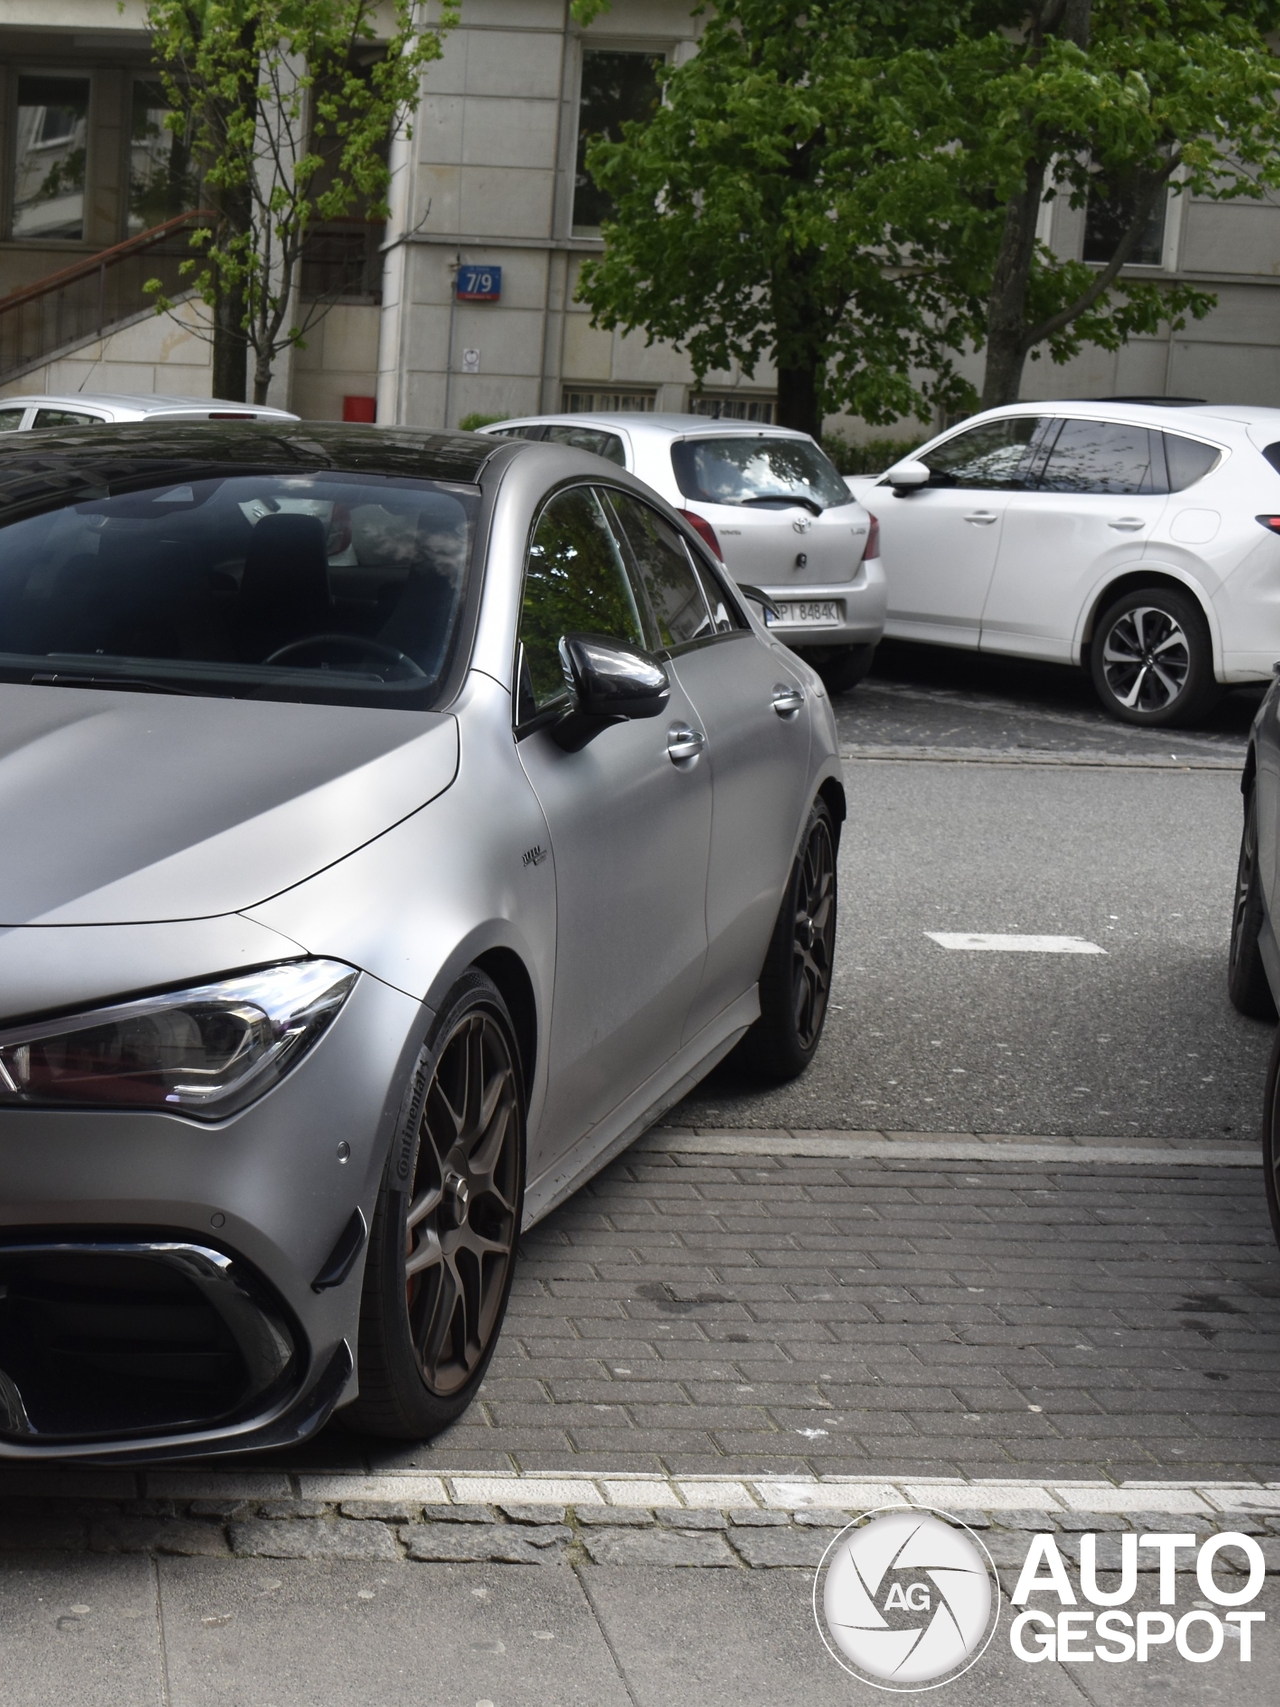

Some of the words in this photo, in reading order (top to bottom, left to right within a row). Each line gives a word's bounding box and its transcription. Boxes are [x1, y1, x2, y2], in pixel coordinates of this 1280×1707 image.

[466, 273, 492, 294] 7/9
[800, 603, 836, 620] 8484K
[397, 1069, 426, 1182] Continental
